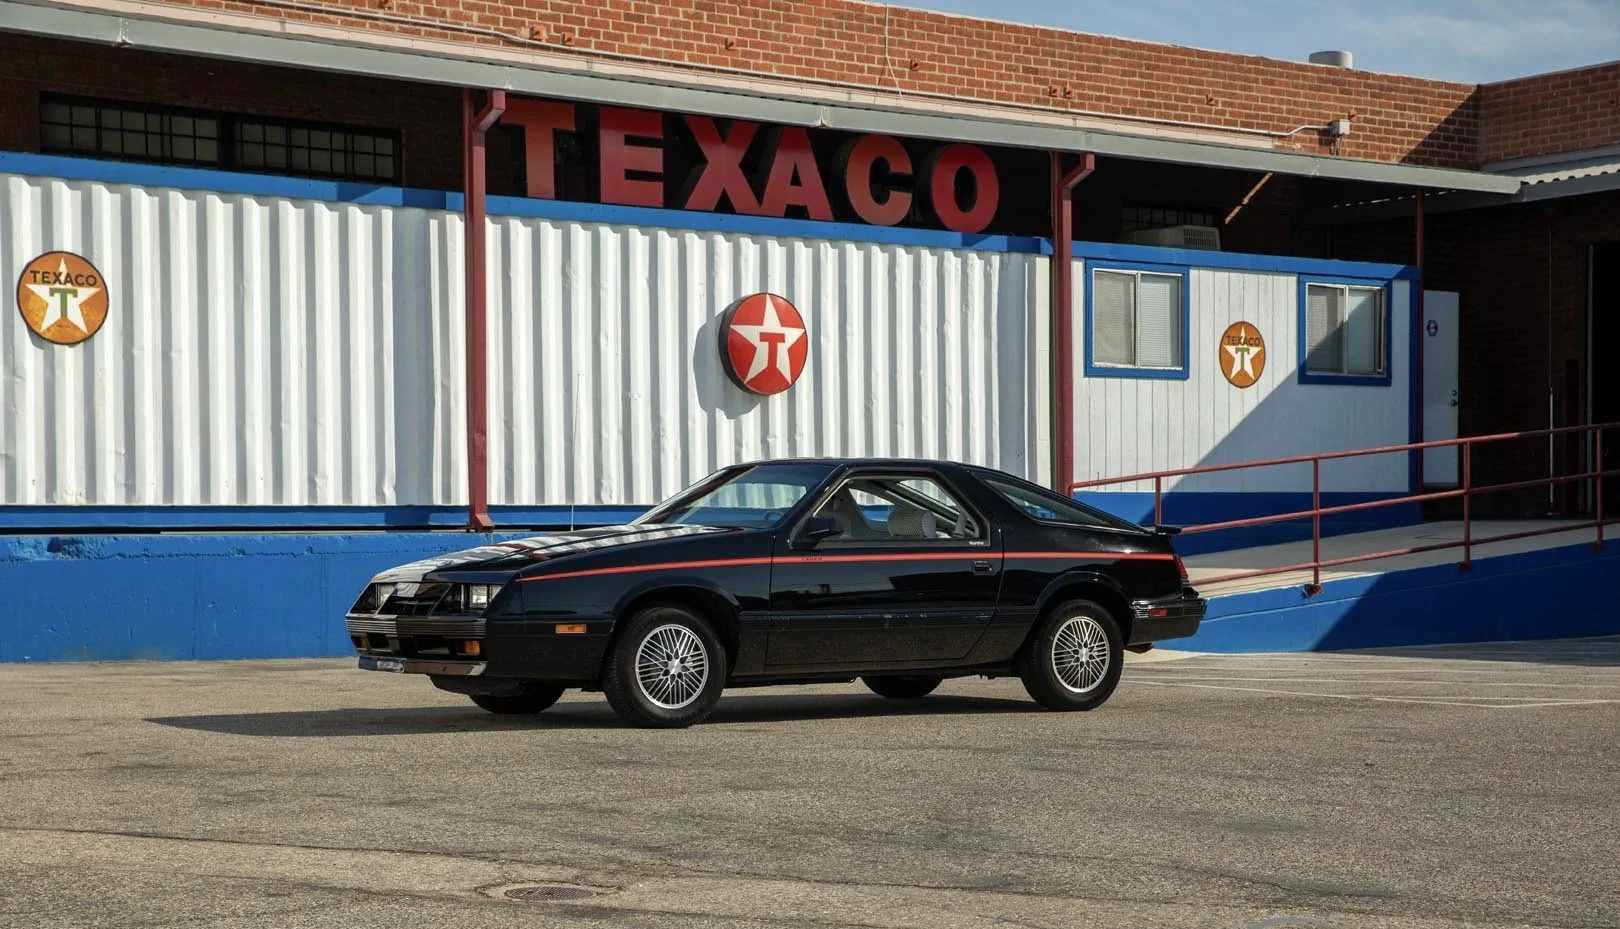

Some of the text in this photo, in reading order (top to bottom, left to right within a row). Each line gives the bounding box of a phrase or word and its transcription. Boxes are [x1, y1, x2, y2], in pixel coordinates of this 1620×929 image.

[500, 99, 1000, 232] TEXACO
[30, 270, 97, 287] TEXACO
[49, 287, 78, 319] T
[759, 332, 785, 370] T
[1225, 335, 1260, 347] TEXACO
[1235, 347, 1250, 369] T
